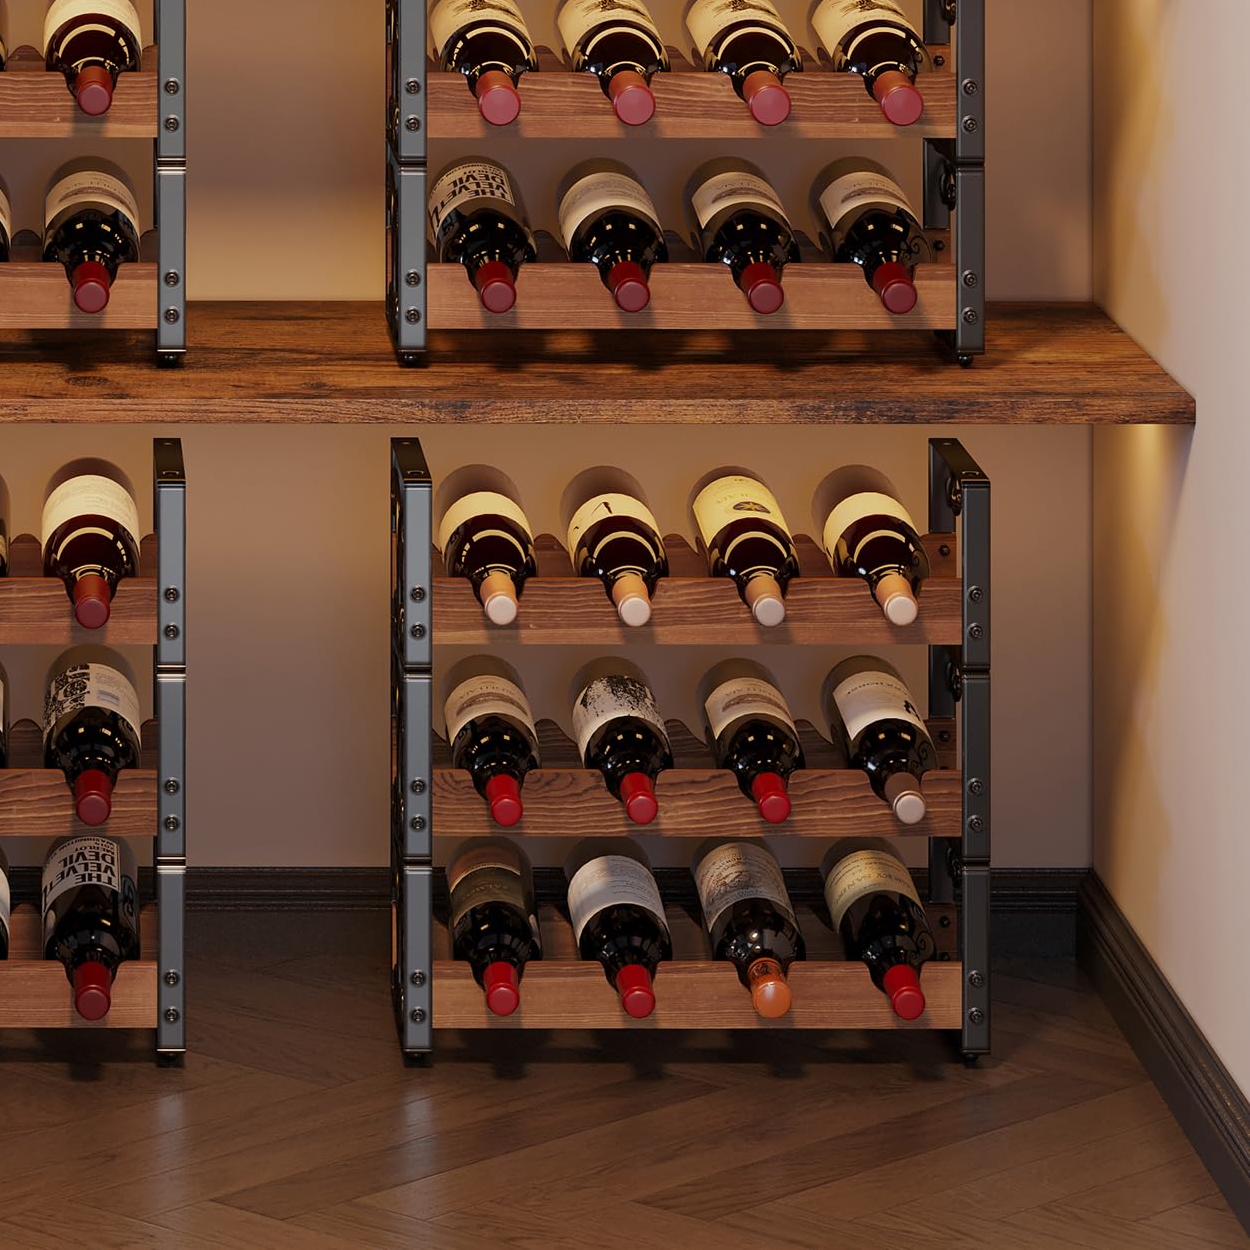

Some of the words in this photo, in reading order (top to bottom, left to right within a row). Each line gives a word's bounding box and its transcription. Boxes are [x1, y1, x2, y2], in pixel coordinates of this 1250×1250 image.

[447, 173, 505, 189] DEVIL
[468, 189, 510, 201] THE
[74, 845, 114, 855] MERLOT
[58, 851, 115, 867] DEVIL
[74, 873, 116, 888] THE
